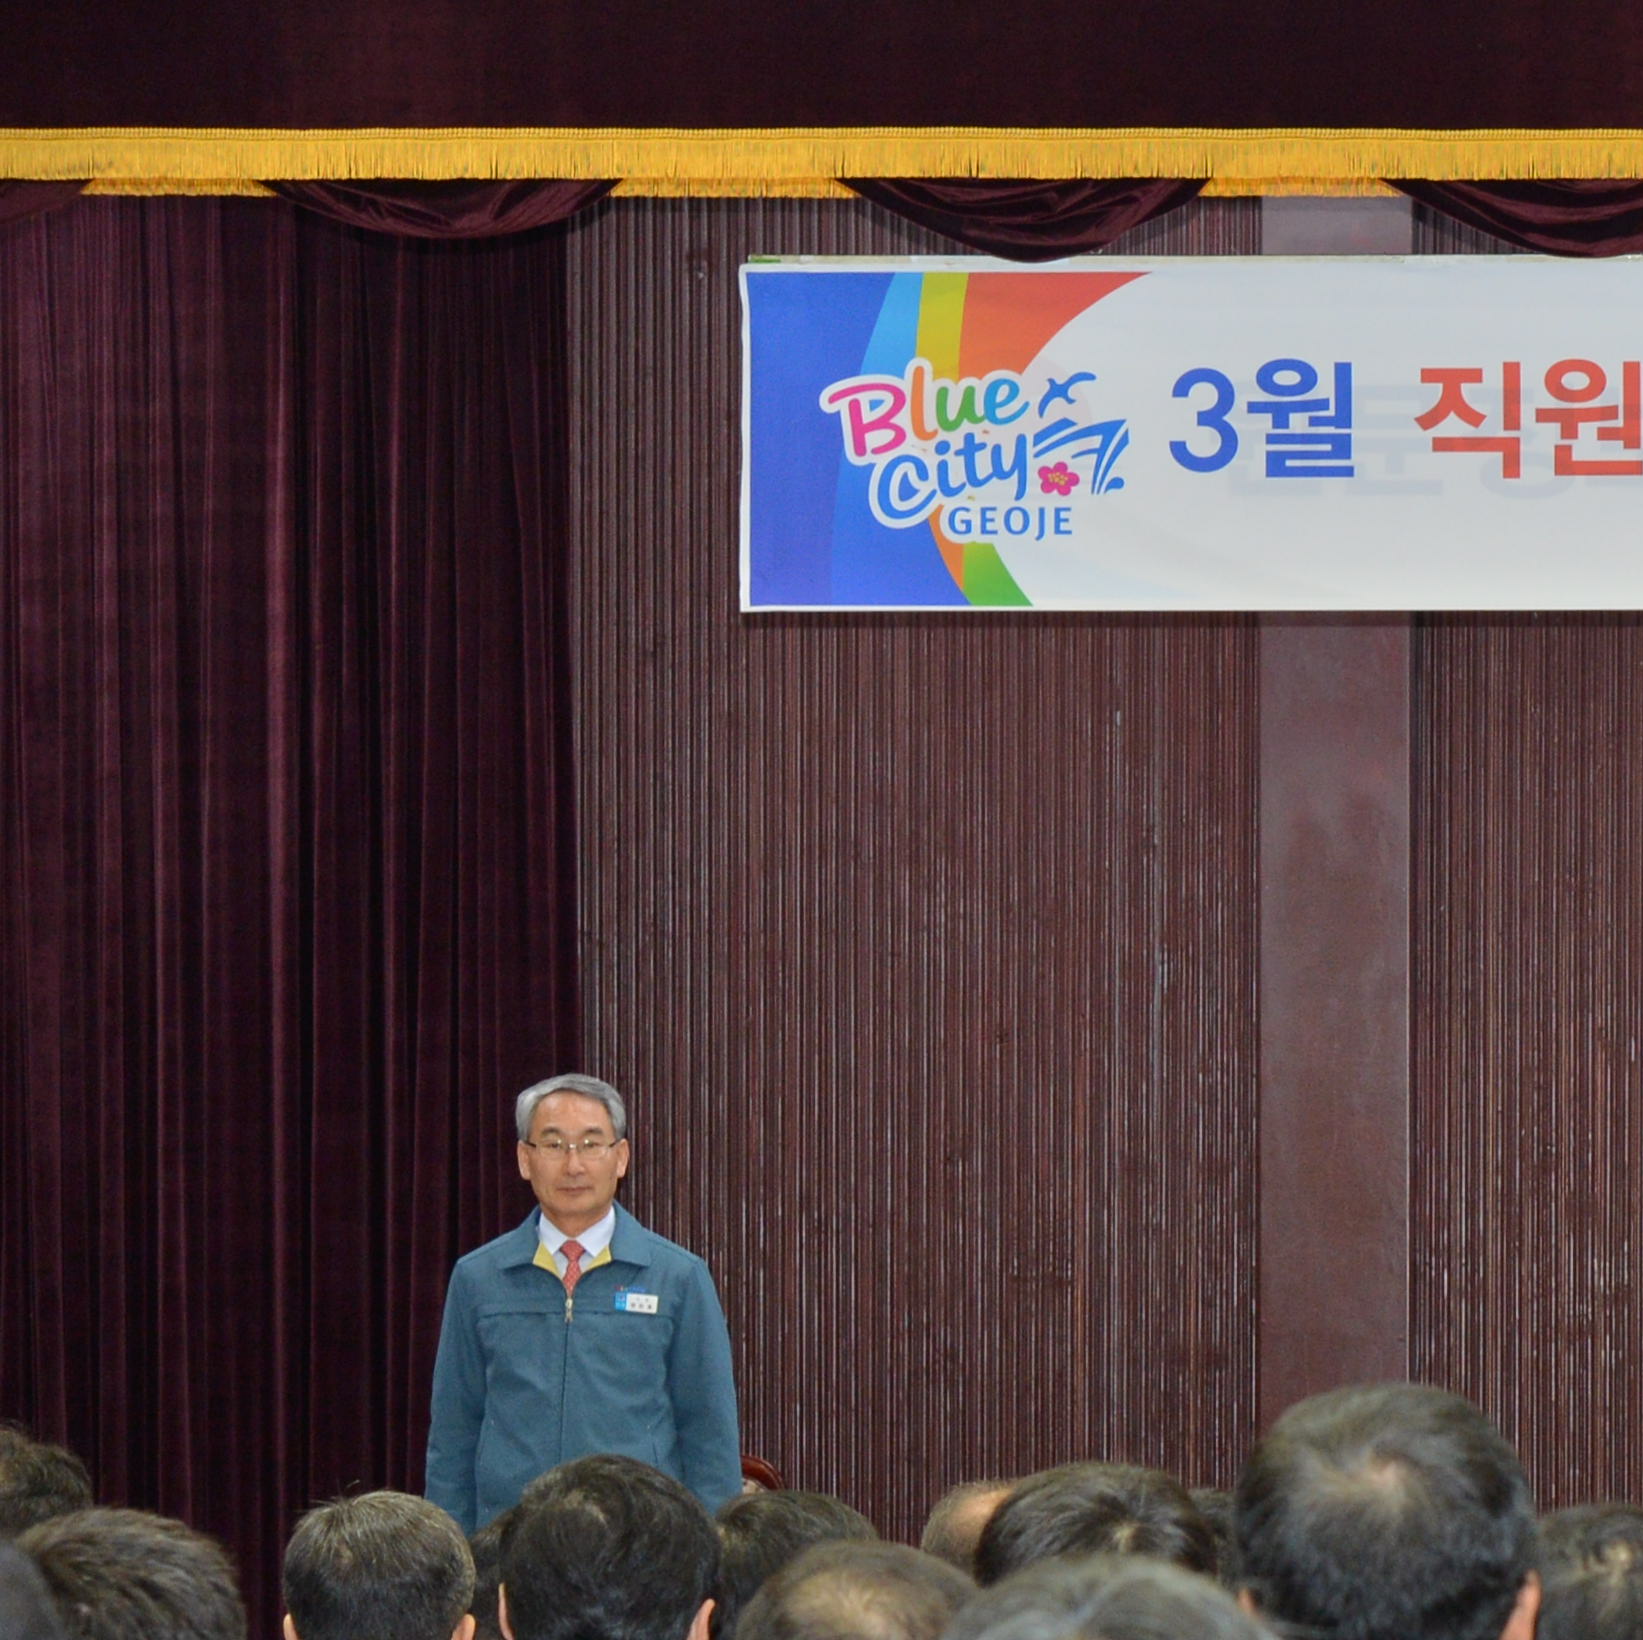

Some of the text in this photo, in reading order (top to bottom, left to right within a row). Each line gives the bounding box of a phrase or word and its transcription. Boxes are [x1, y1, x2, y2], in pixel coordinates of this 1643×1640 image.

[824, 359, 1030, 456] Blue
[1168, 358, 1356, 479] 3월
[878, 430, 1029, 520] City
[947, 504, 1074, 541] GEOJE
